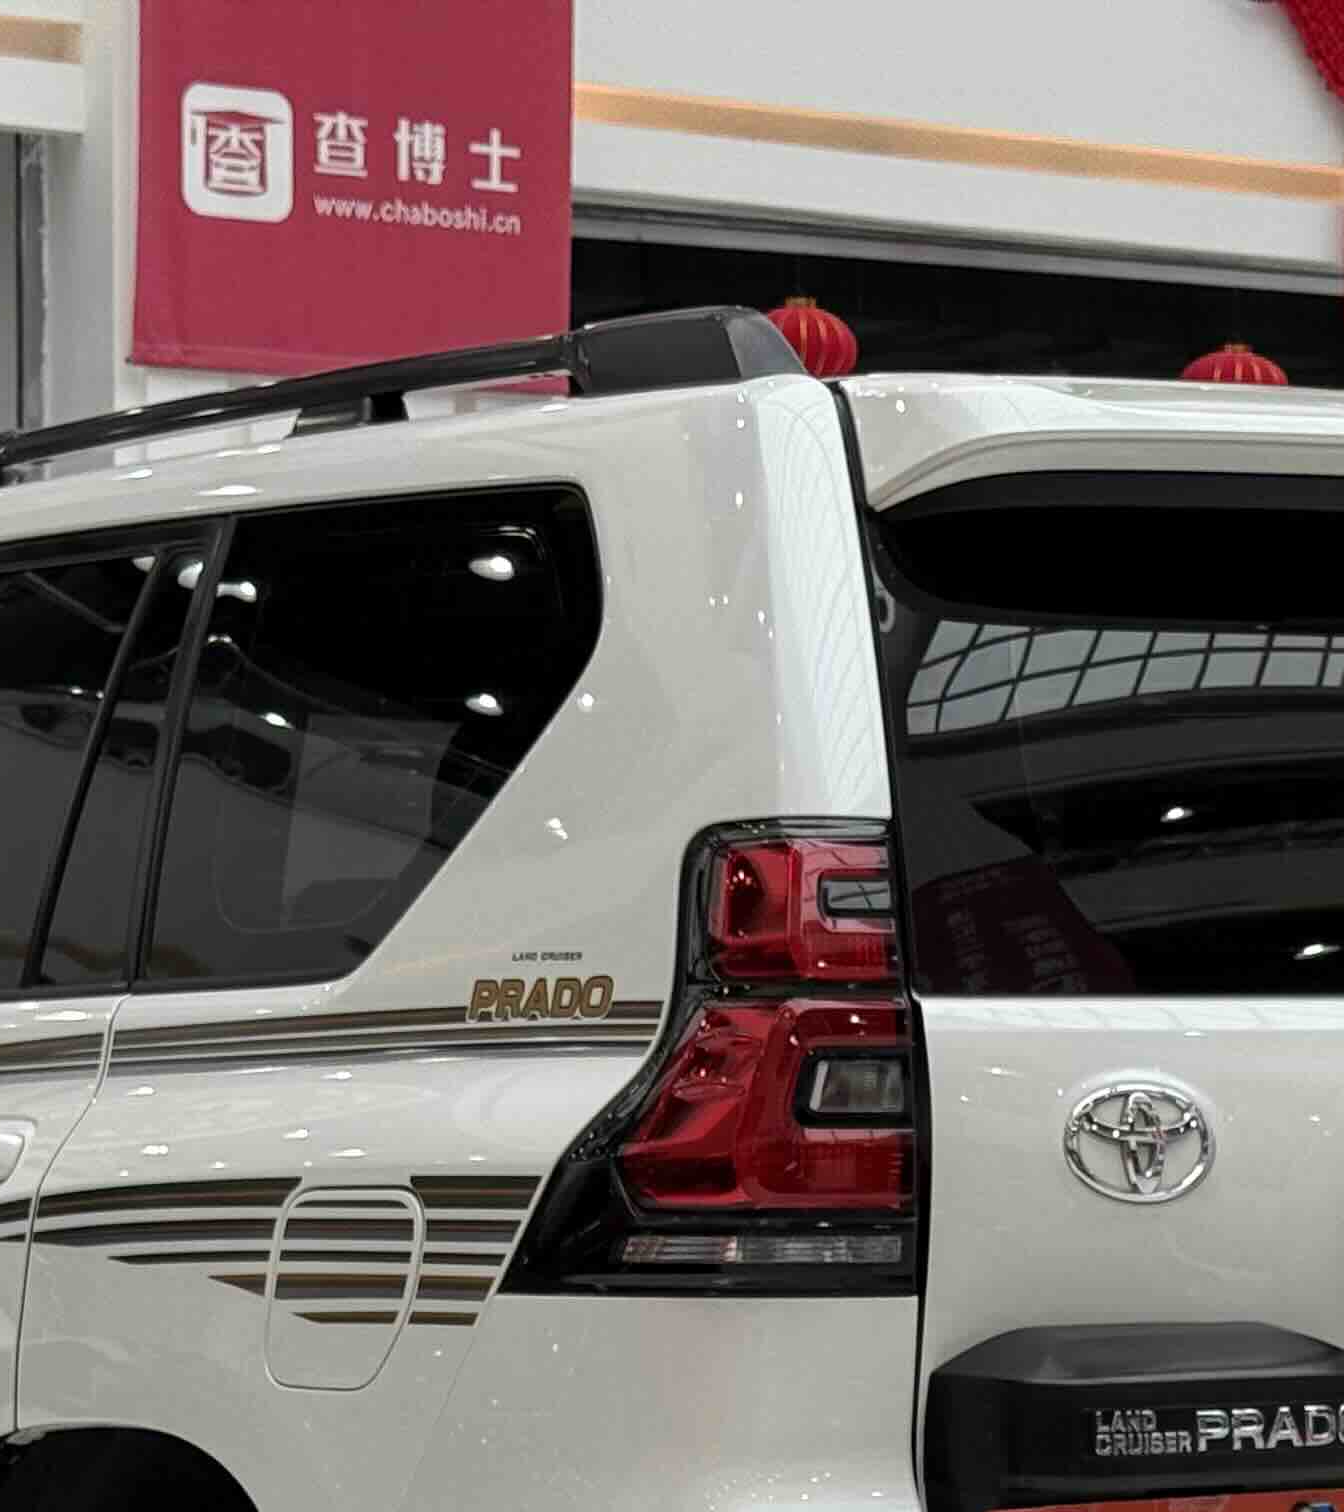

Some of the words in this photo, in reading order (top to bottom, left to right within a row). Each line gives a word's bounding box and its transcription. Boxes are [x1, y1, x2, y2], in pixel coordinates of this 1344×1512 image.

[313, 111, 521, 194] 查博士
[312, 193, 521, 235] www.chaboshi.cn
[466, 975, 615, 1023] PRADO
[1094, 1409, 1157, 1433] LAND
[1094, 1430, 1193, 1457] CRUISER
